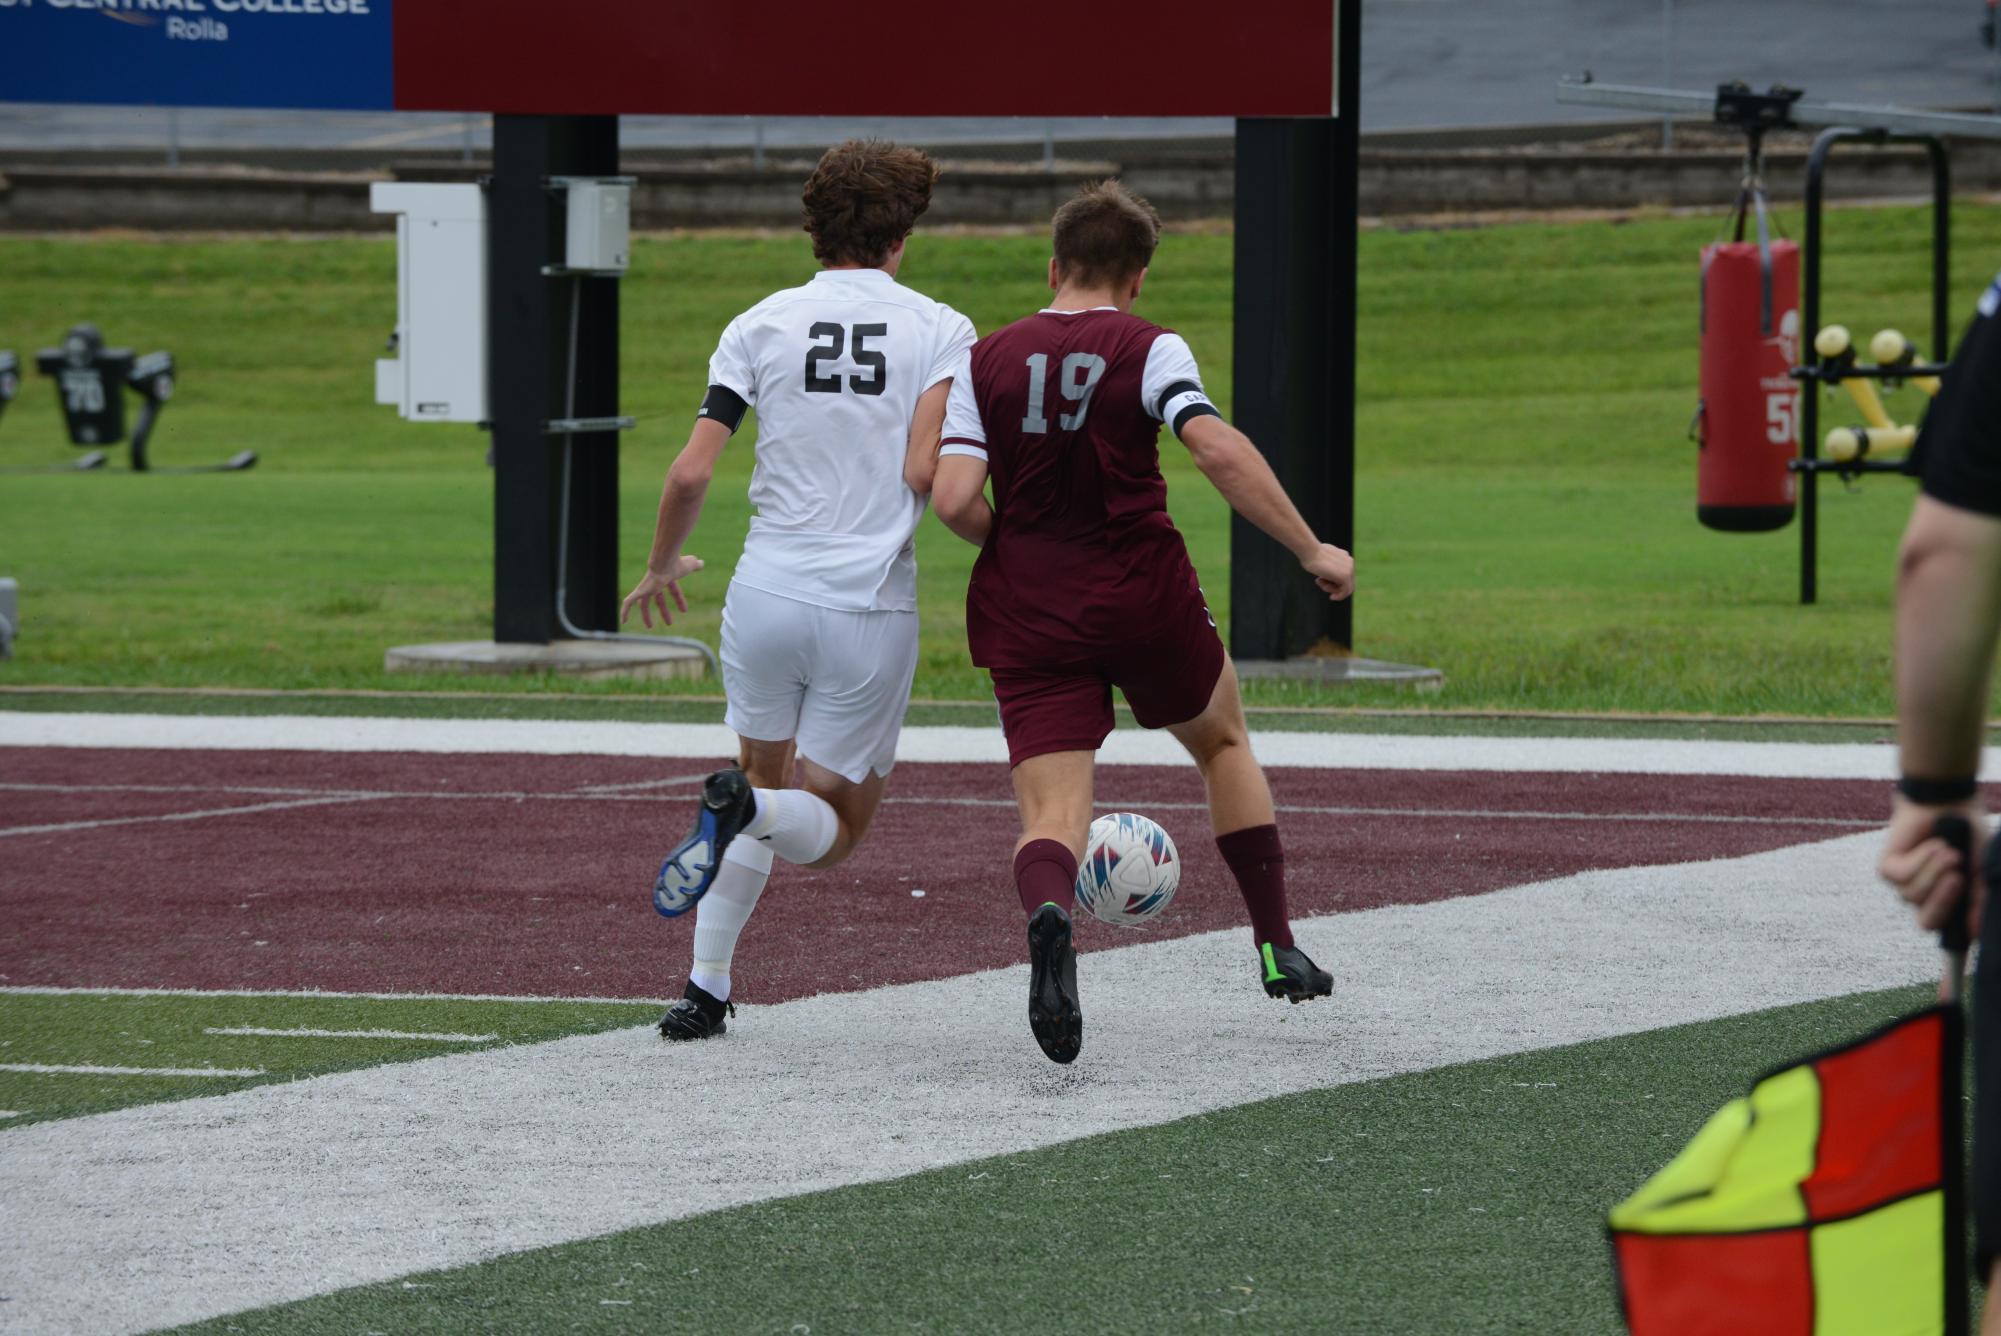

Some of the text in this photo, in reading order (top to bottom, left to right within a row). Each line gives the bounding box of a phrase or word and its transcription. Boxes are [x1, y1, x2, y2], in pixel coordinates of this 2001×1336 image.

[166, 17, 228, 40] Rolla
[805, 321, 887, 396] 25
[1022, 352, 1107, 433] 19
